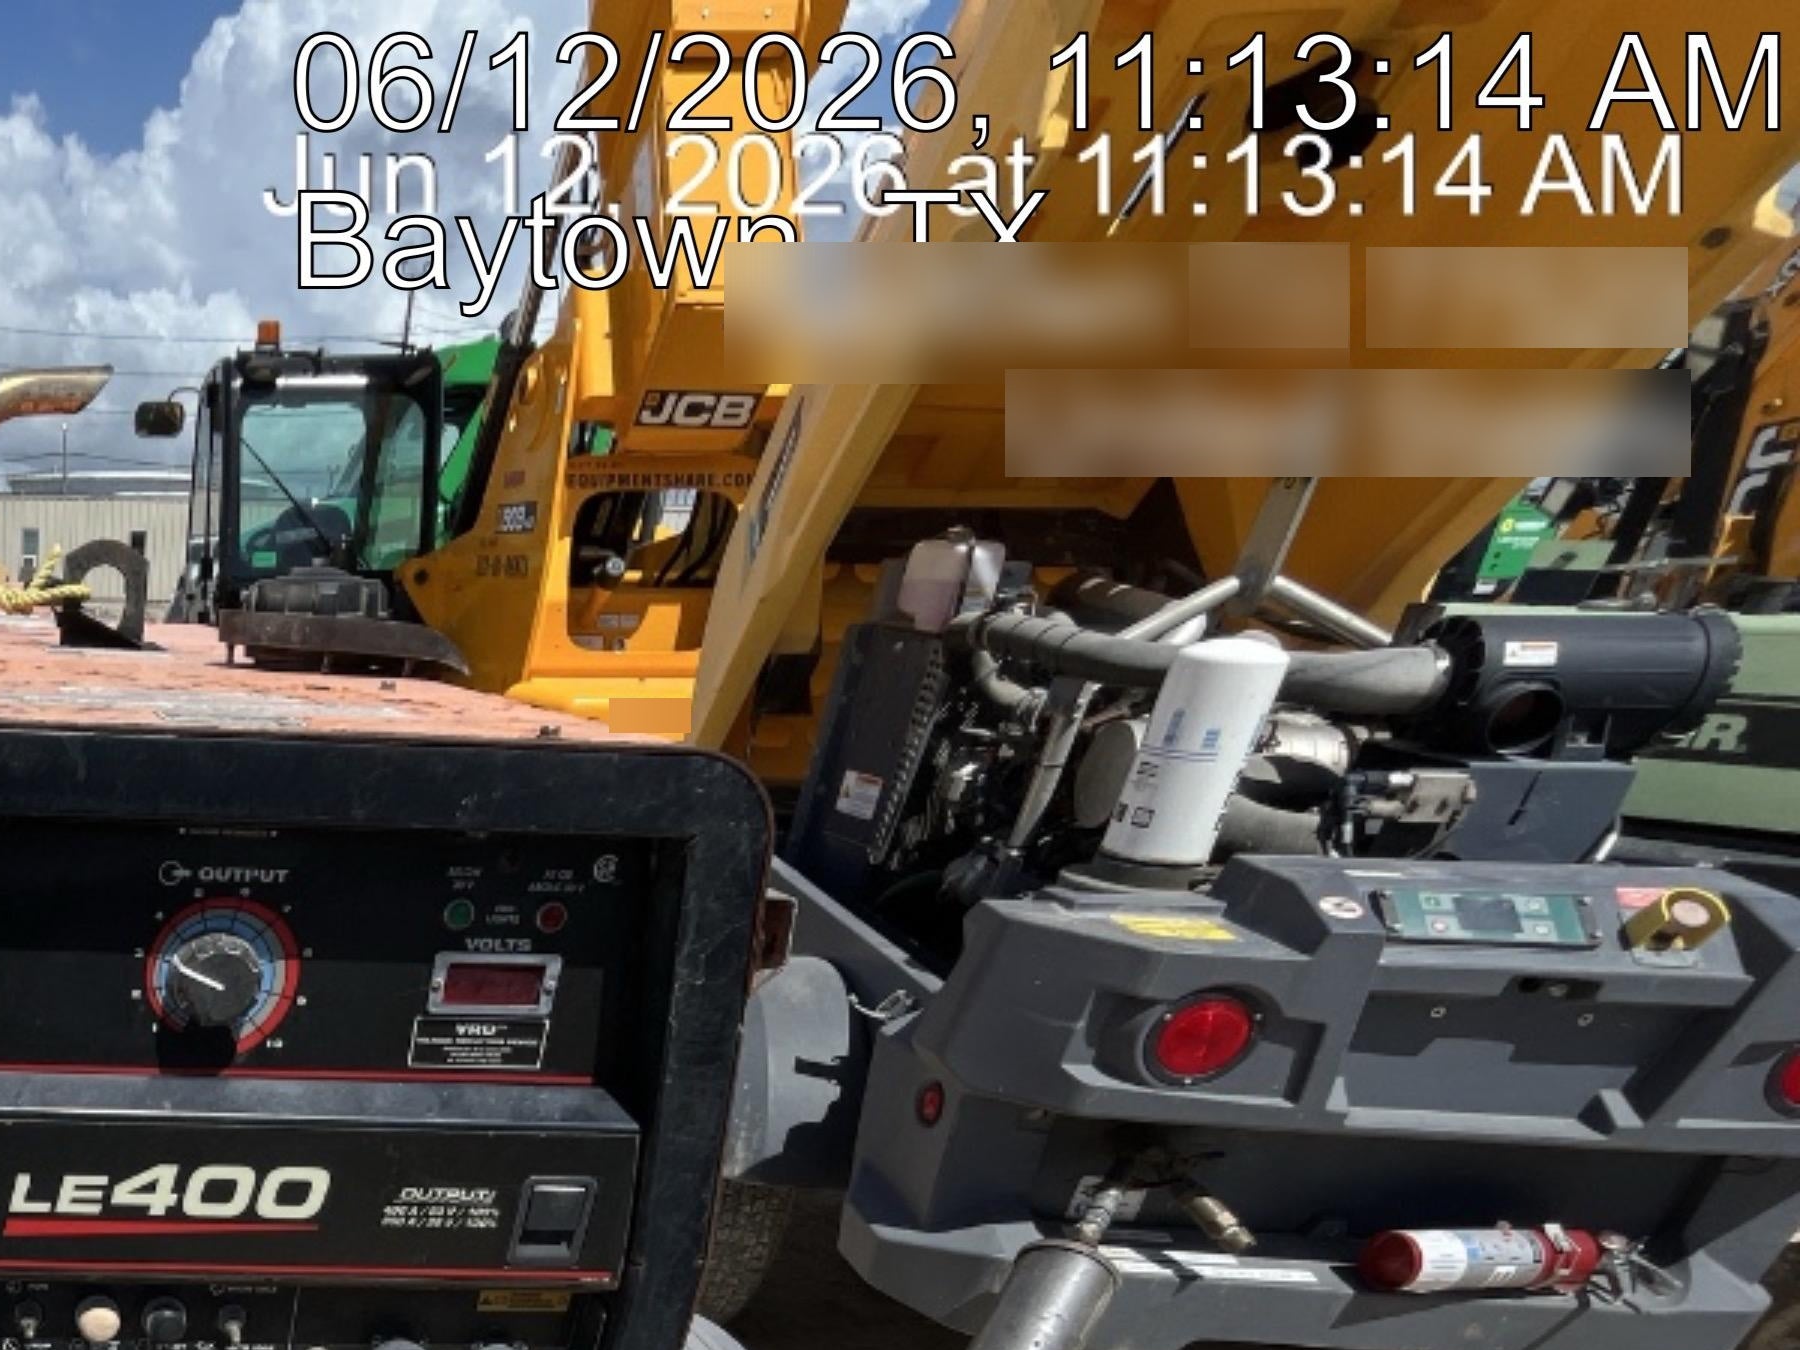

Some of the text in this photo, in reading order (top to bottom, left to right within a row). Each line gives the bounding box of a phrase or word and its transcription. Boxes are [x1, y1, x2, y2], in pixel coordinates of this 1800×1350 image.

[638, 393, 757, 428] JCB
[198, 866, 289, 883] OUTPUT
[465, 938, 532, 952] VOLTS
[7, 1165, 331, 1221] LE400
